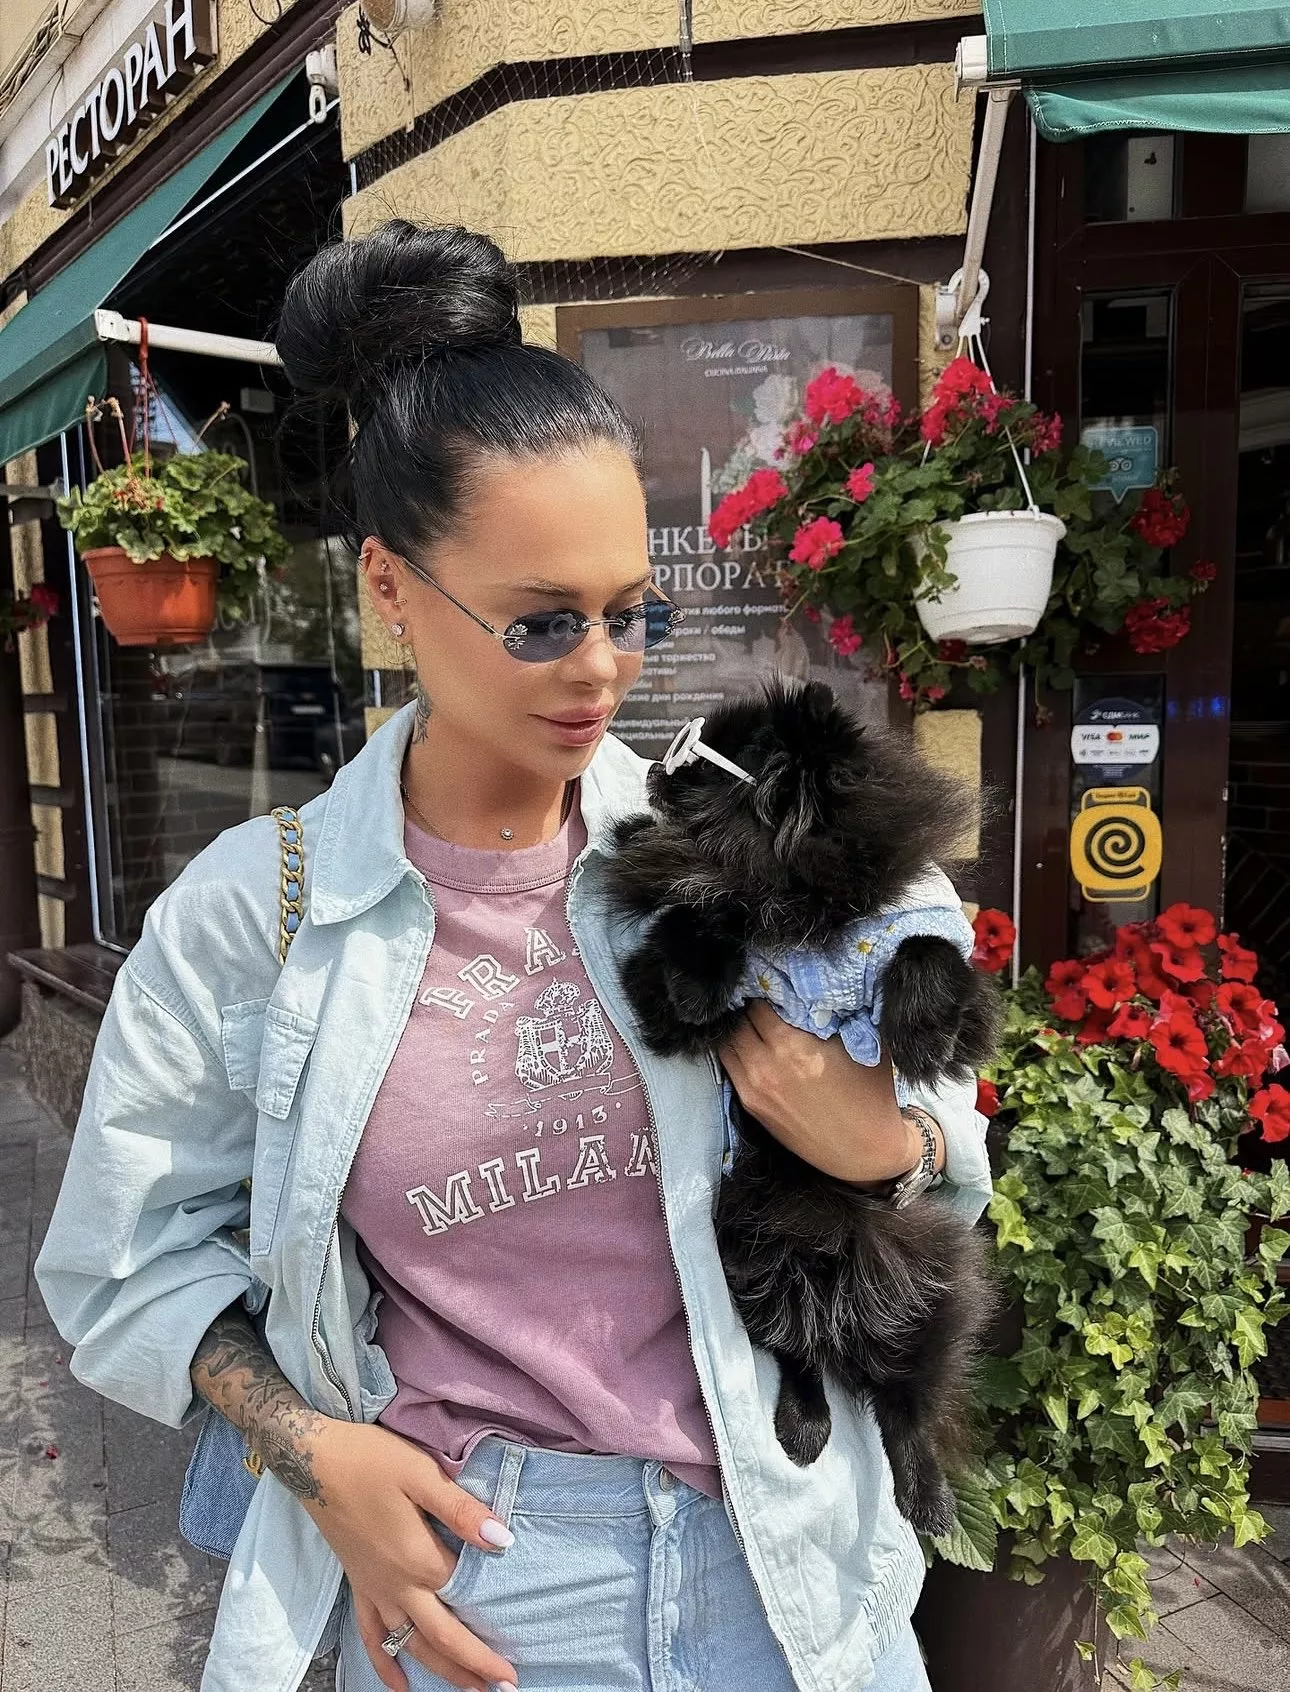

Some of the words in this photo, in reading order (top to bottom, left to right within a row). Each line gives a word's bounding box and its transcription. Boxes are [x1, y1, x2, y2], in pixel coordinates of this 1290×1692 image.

[45, 0, 198, 208] РЕСТОРАН
[702, 605, 741, 615] любого
[711, 624, 746, 635] обеды
[651, 693, 672, 703] дни
[673, 692, 725, 703] рождения
[418, 927, 580, 1020] PRA
[471, 1001, 516, 1086] PRADA
[534, 1105, 608, 1138] 1913
